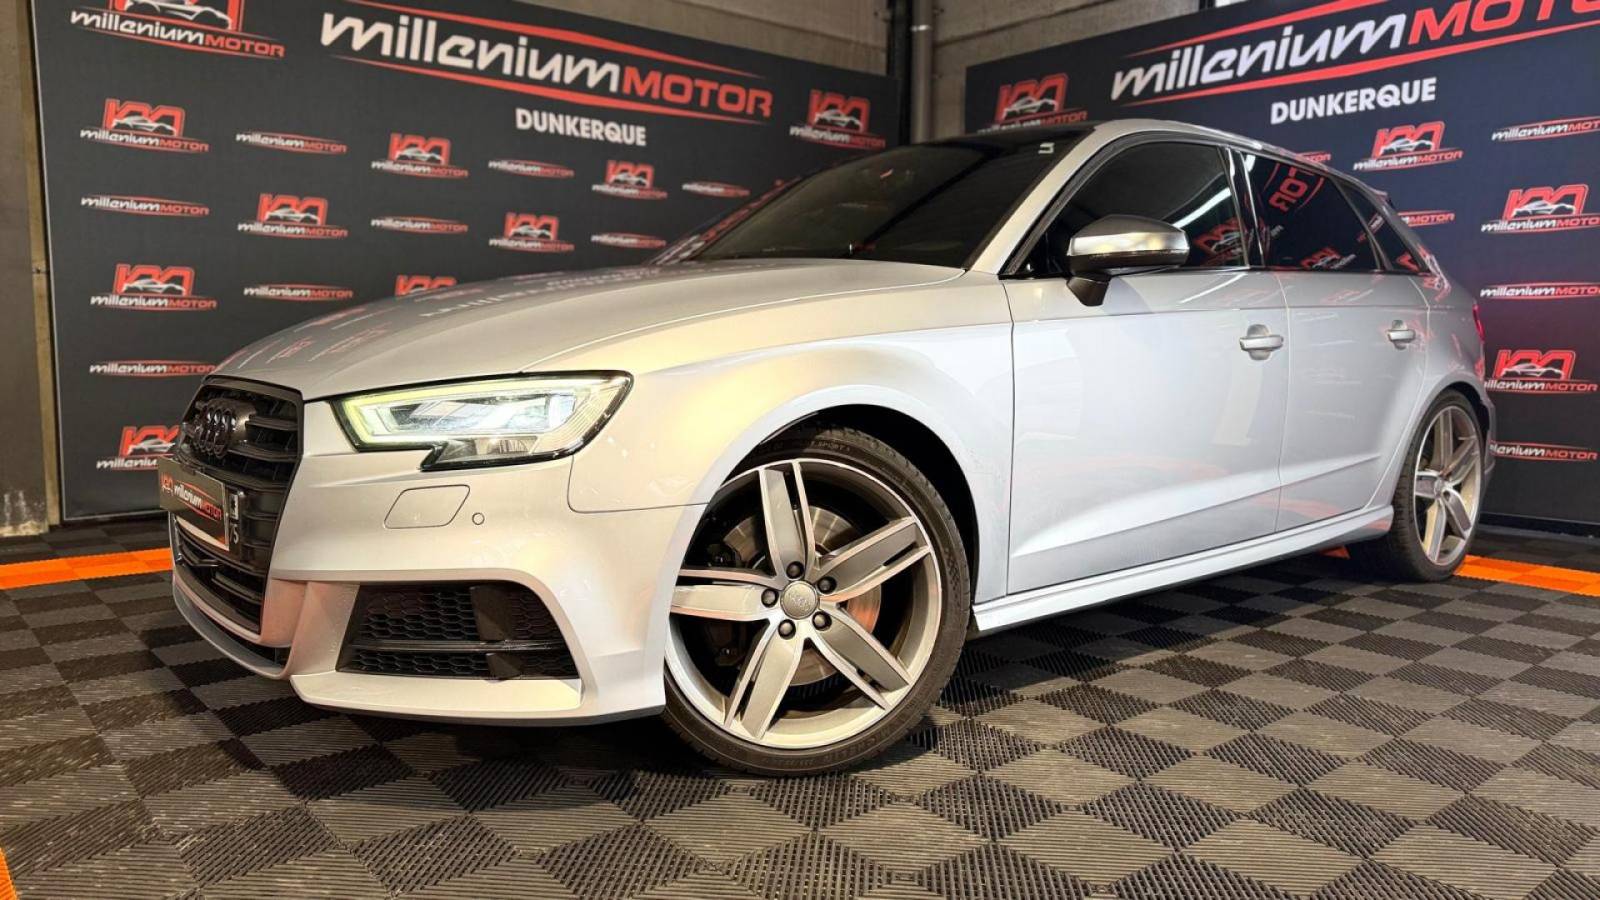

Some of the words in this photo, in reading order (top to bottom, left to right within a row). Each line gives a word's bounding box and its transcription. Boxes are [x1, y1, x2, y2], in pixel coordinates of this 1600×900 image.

[71, 10, 285, 57] milleniumMOTOR
[321, 12, 773, 117] milleniumMOTOR
[1271, 77, 1437, 125] DUNKERQUE
[515, 107, 647, 146] DUNKERQUE
[1491, 120, 1600, 141] milleniumMOT
[1481, 216, 1600, 232] milleniumMOTO
[1480, 286, 1600, 297] milleniumMOTO
[96, 457, 157, 469] milleniu
